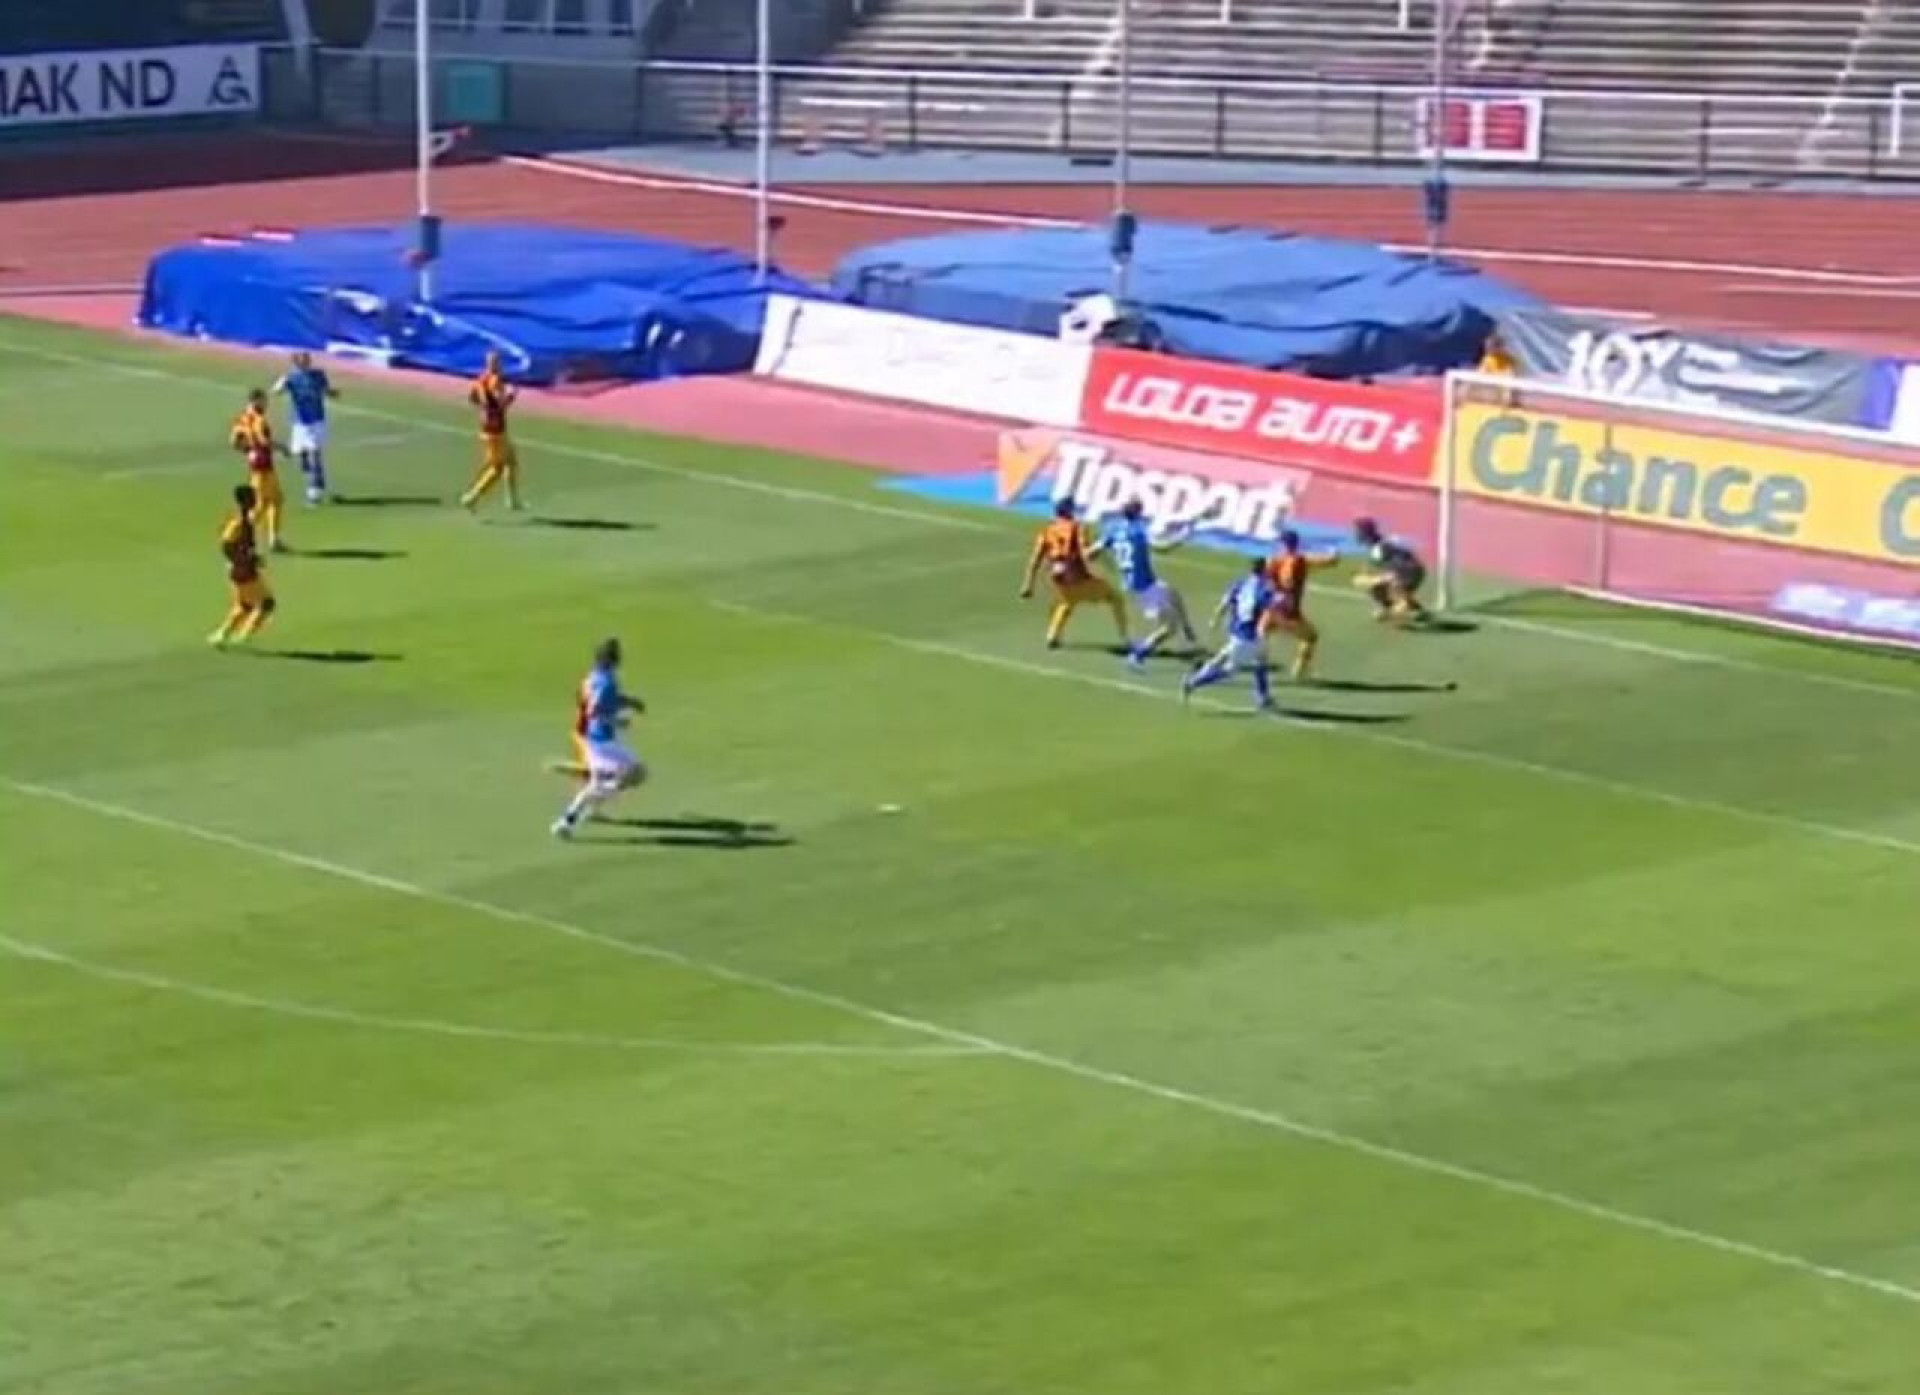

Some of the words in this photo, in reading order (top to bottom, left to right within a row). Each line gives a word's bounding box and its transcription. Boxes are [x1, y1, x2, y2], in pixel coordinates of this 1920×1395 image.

[0, 62, 80, 116] AK
[100, 59, 176, 112] ND
[1053, 442, 1291, 546] Tipsport
[1468, 416, 1806, 535] Chance
